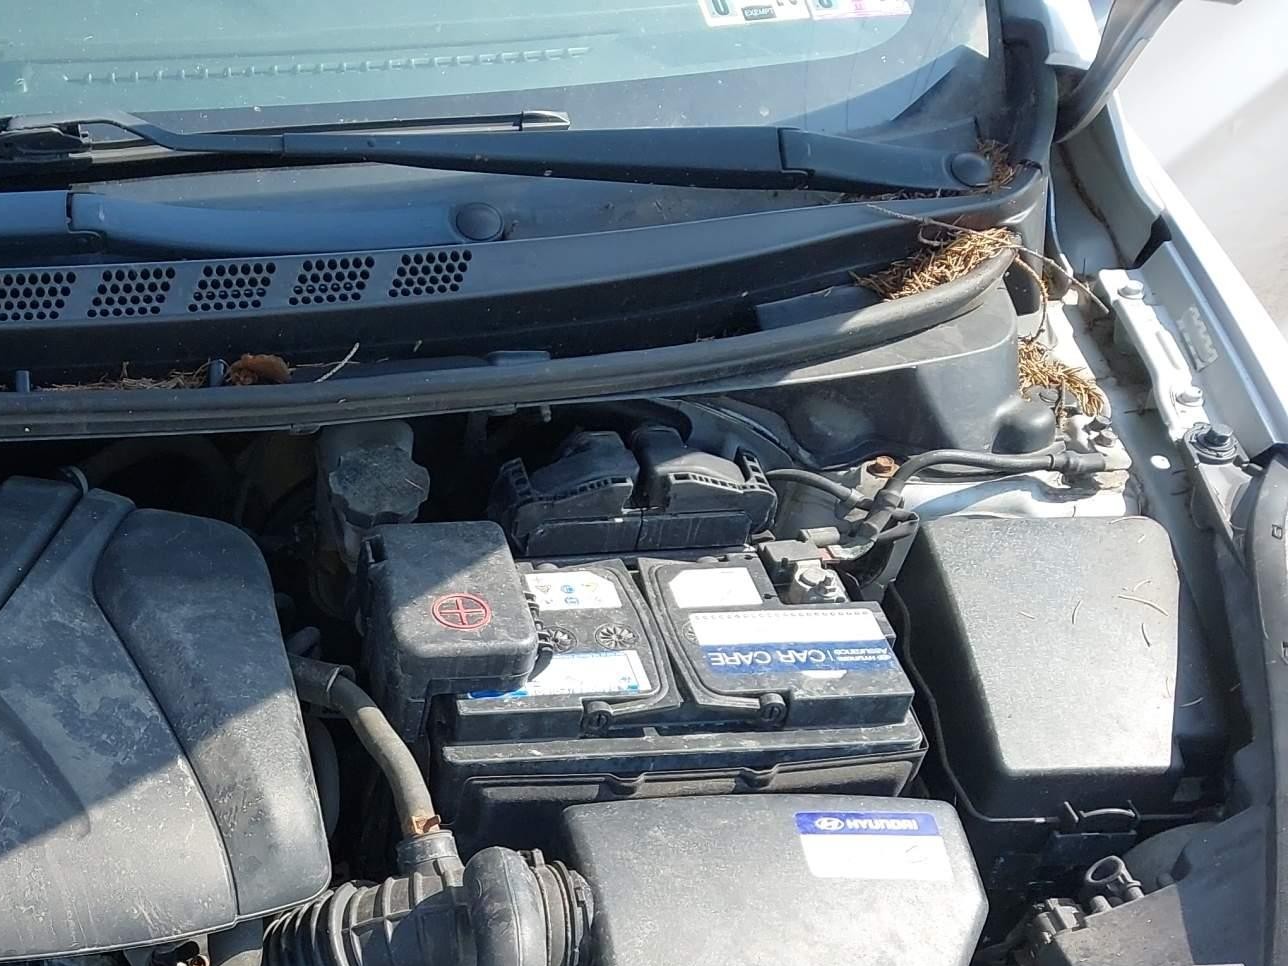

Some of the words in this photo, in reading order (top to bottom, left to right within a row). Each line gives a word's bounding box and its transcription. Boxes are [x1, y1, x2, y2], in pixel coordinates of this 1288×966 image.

[708, 651, 773, 667] CARE
[778, 648, 826, 664] CAR
[845, 818, 919, 831] HYUNDAI
